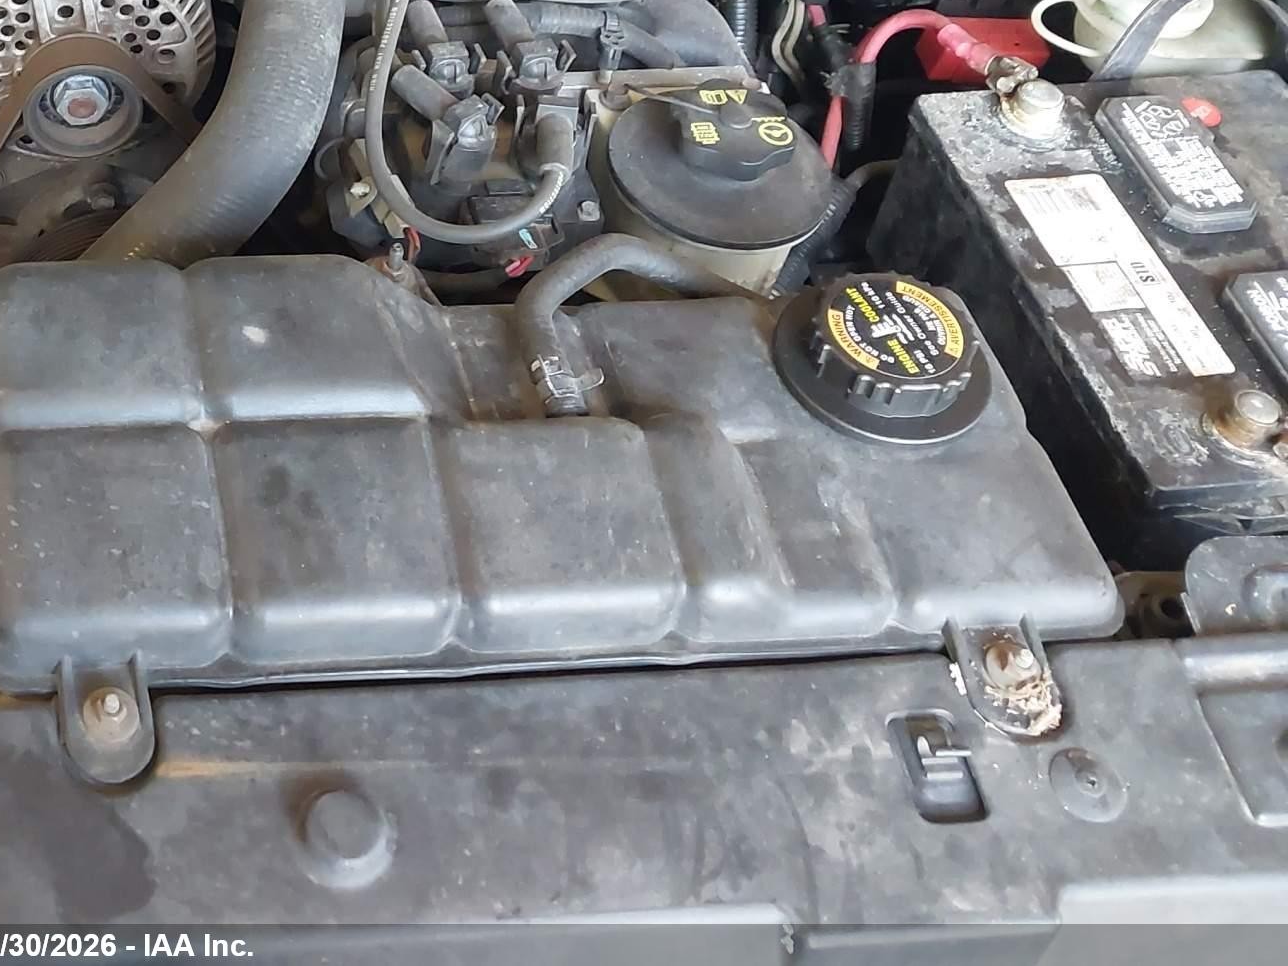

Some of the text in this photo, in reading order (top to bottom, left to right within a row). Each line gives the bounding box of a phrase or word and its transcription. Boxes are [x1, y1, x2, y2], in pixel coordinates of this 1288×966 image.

[884, 291, 907, 315] Guide
[901, 284, 960, 346] AVERTISSEMENT
[832, 314, 861, 357] WARNING
[846, 287, 920, 374] ENGINE COOLANT
[847, 322, 862, 343] OPEN
[903, 314, 927, 340] Owner
[860, 342, 880, 360] NOT
[880, 353, 895, 364] DO
